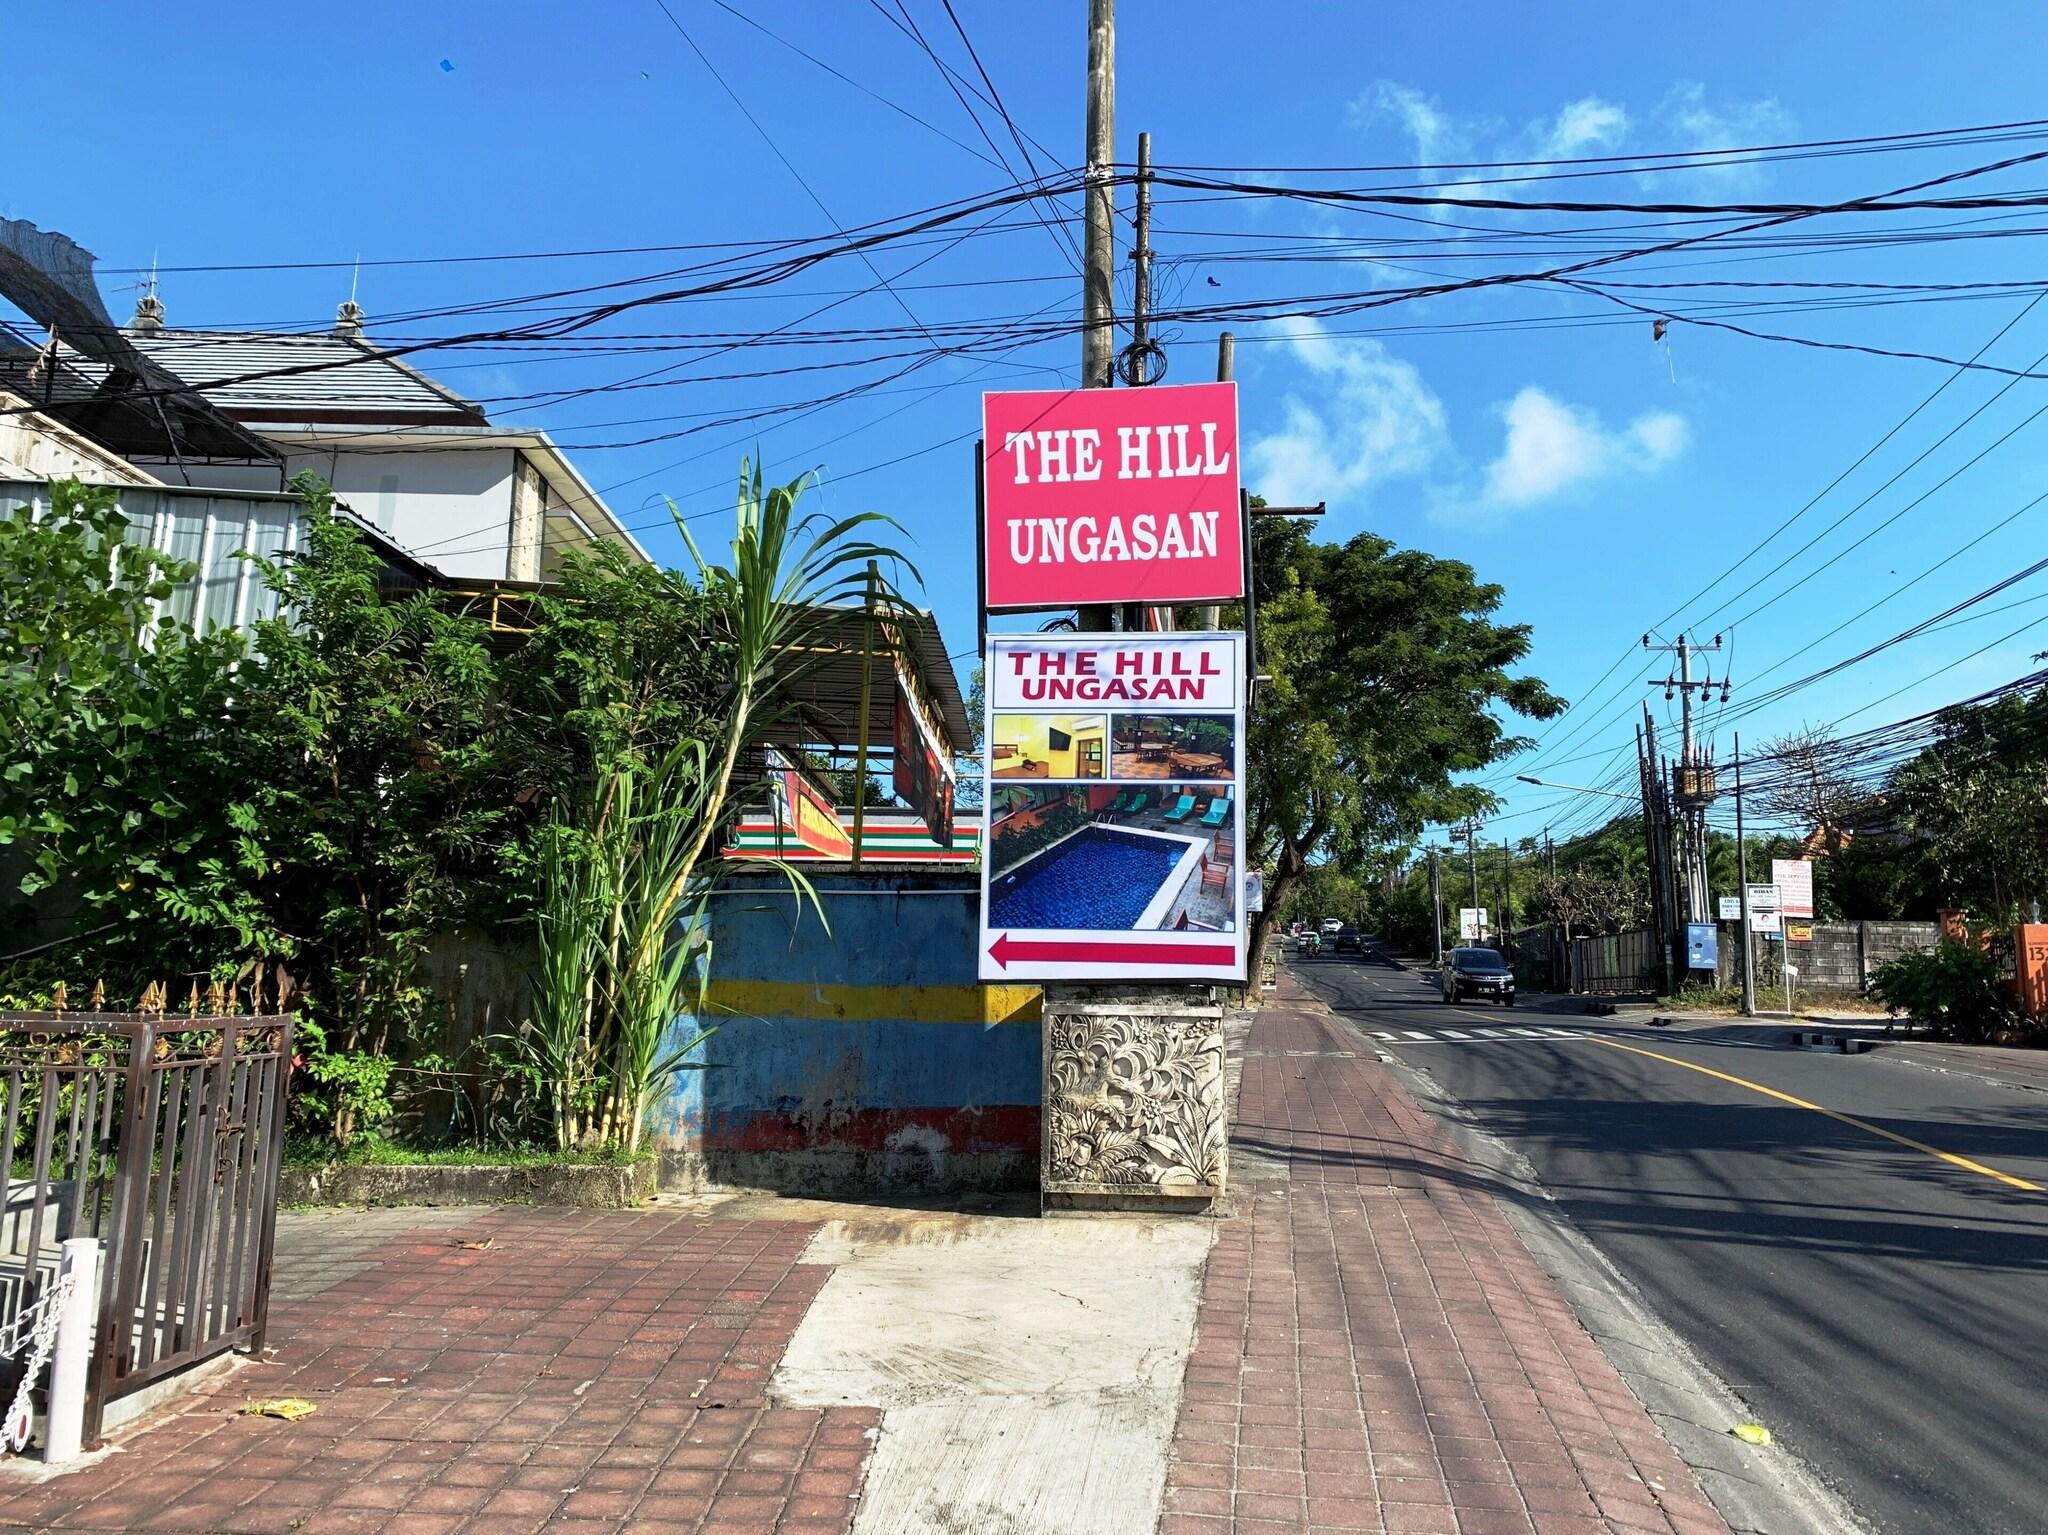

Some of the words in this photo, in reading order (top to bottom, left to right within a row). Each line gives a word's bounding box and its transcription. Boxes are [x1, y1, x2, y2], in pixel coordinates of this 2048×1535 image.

[1004, 428, 1103, 485] THE
[1117, 422, 1231, 480] HILL
[1007, 511, 1220, 565] UNGASAN
[1008, 651, 1098, 677] THE
[1114, 651, 1221, 677] HILL
[1021, 677, 1206, 701] UNGASAN
[2029, 947, 2048, 961] 13
